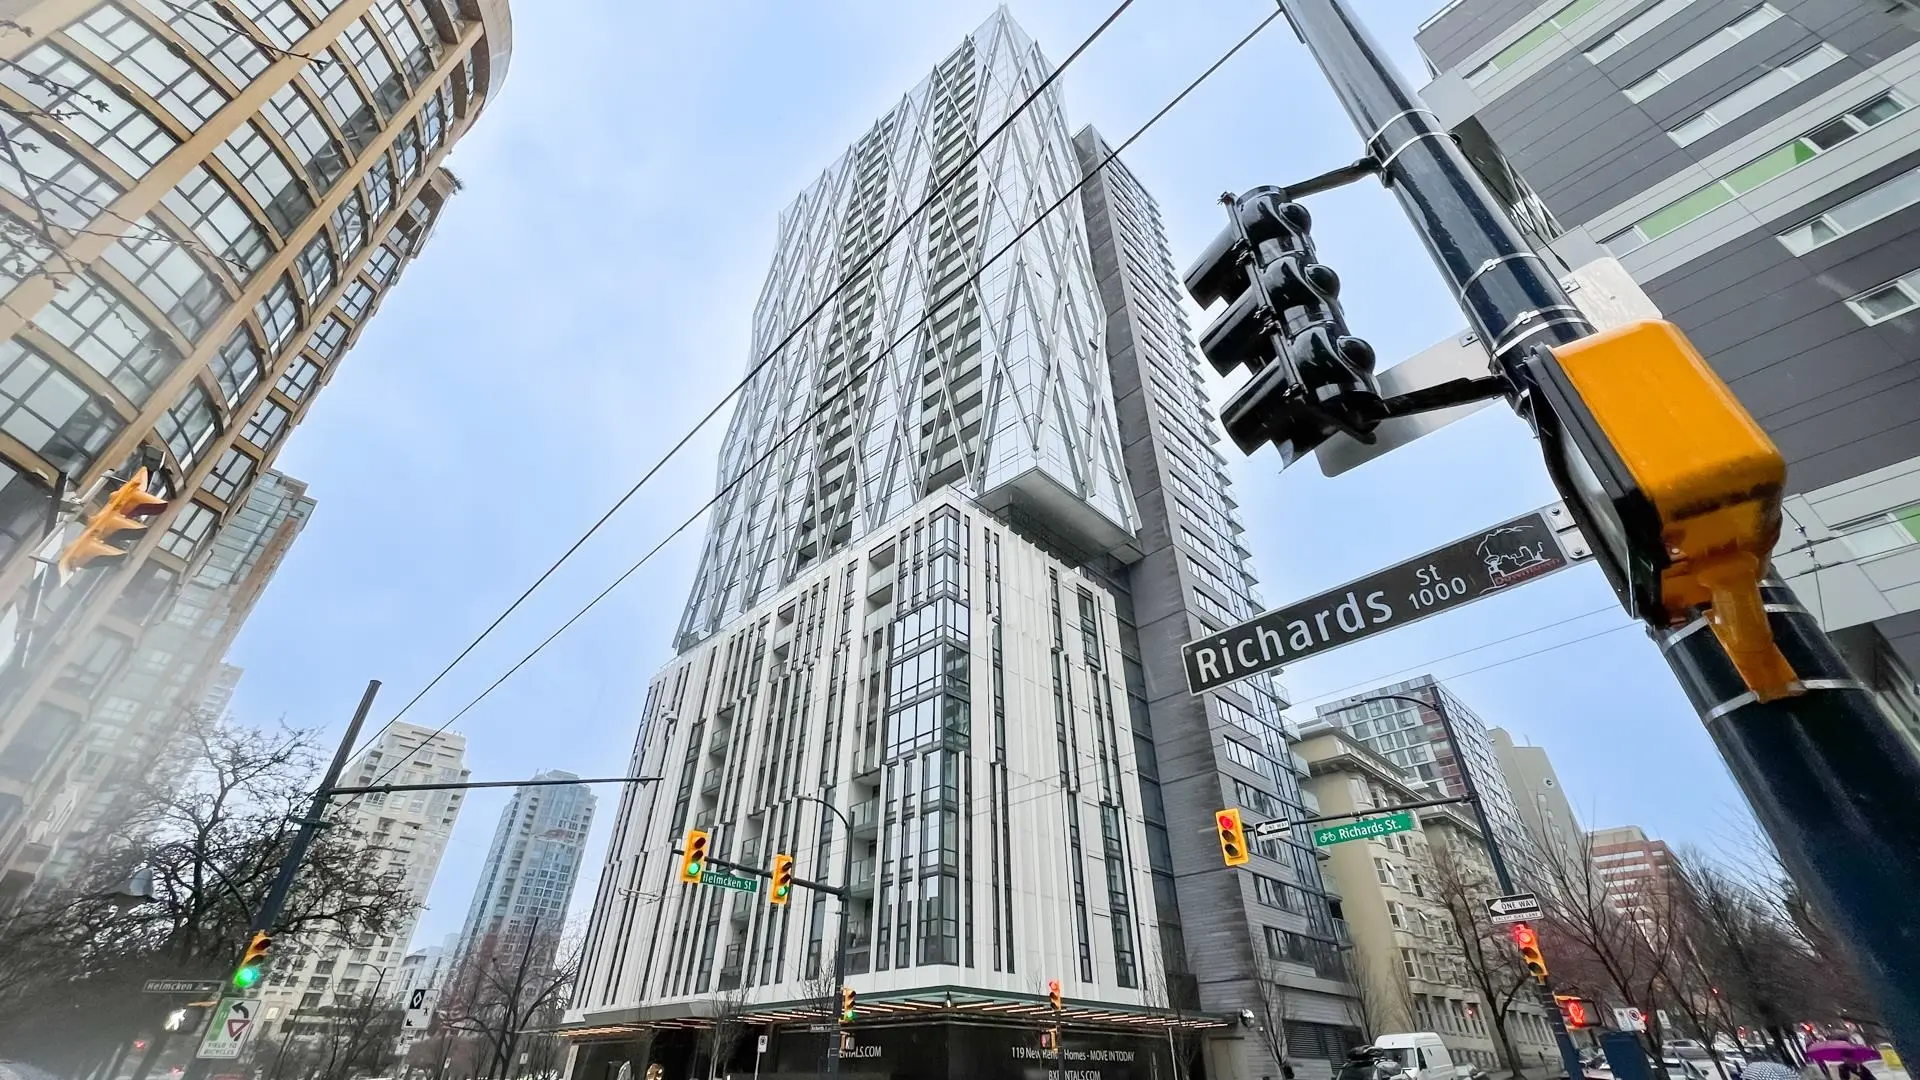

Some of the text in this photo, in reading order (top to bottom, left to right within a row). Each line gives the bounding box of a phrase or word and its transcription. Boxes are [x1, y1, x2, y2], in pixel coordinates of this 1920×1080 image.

[1416, 564, 1441, 586] St
[1408, 577, 1467, 610] 1000
[1195, 590, 1393, 684] Richards
[1338, 819, 1402, 839] Richards St.
[702, 872, 752, 890] Helmcken St
[1501, 899, 1535, 910] ONE WAY
[147, 982, 193, 990] Helmcken
[1011, 1046, 1025, 1058] 119
[1064, 1049, 1086, 1061] Homes
[1090, 1050, 1108, 1061] MOVE
[1109, 1051, 1116, 1061] IN
[1116, 1051, 1135, 1062] TODAY
